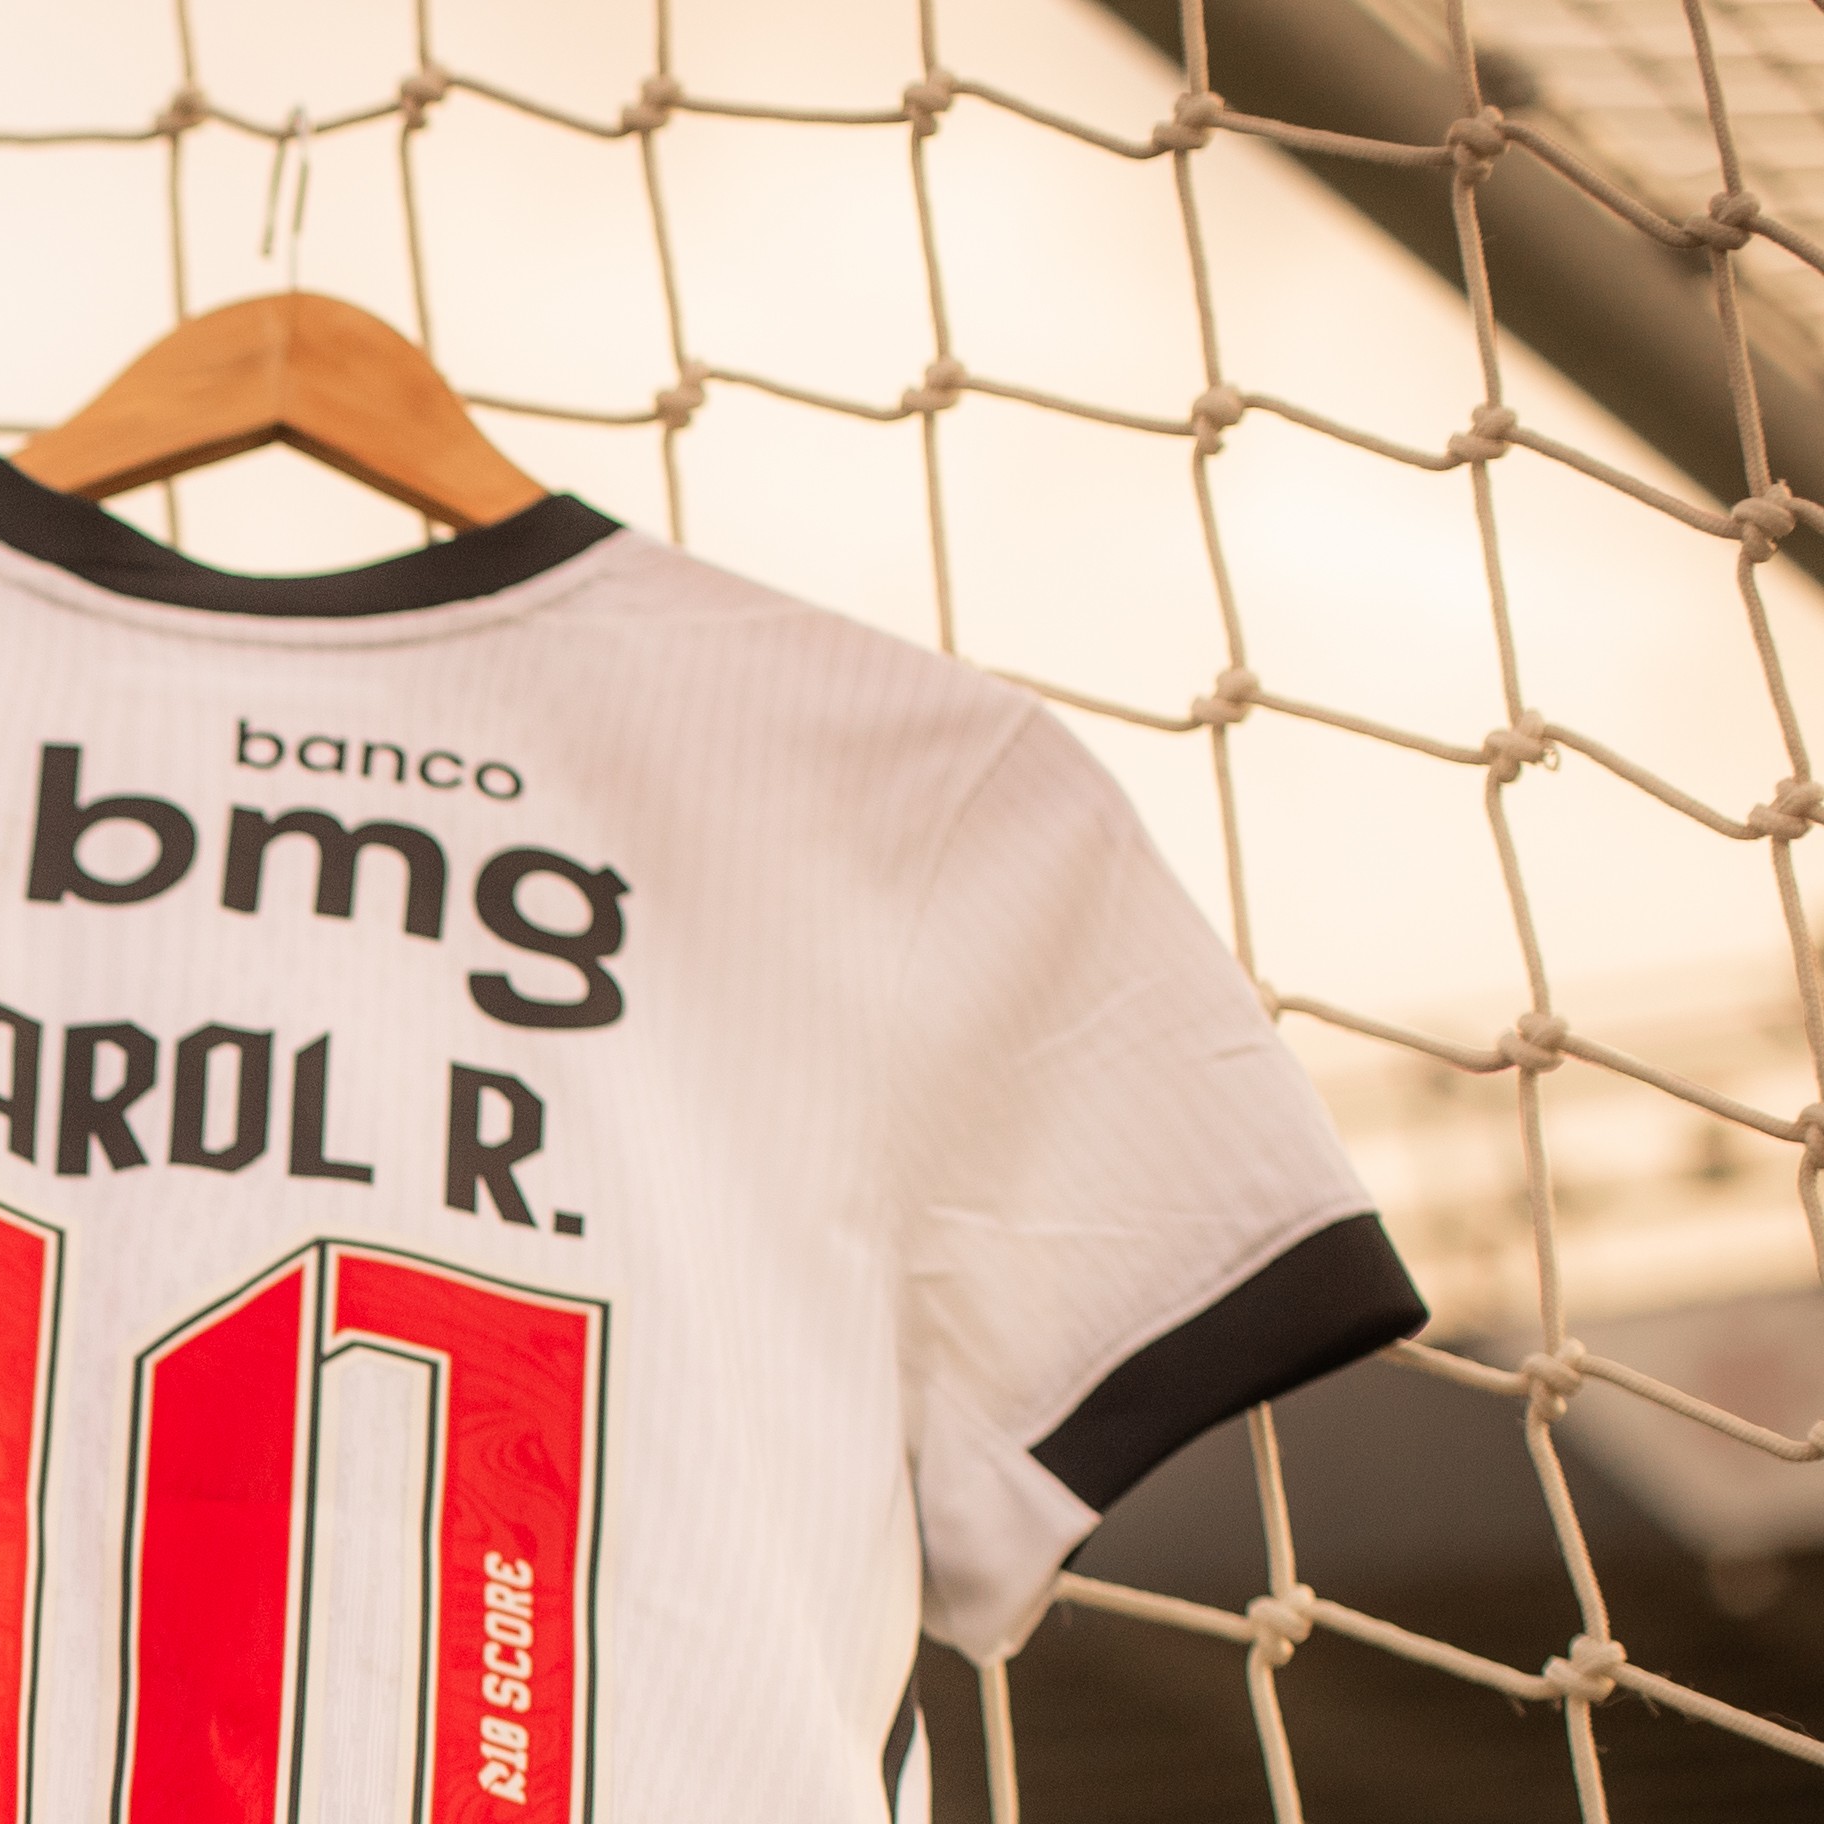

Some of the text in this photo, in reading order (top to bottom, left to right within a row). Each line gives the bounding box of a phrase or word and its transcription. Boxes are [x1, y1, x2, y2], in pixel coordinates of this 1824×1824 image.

[237, 717, 525, 801] banco
[26, 742, 632, 1030] bmg
[443, 1061, 586, 1238] R.
[481, 1549, 535, 1714] SCORE
